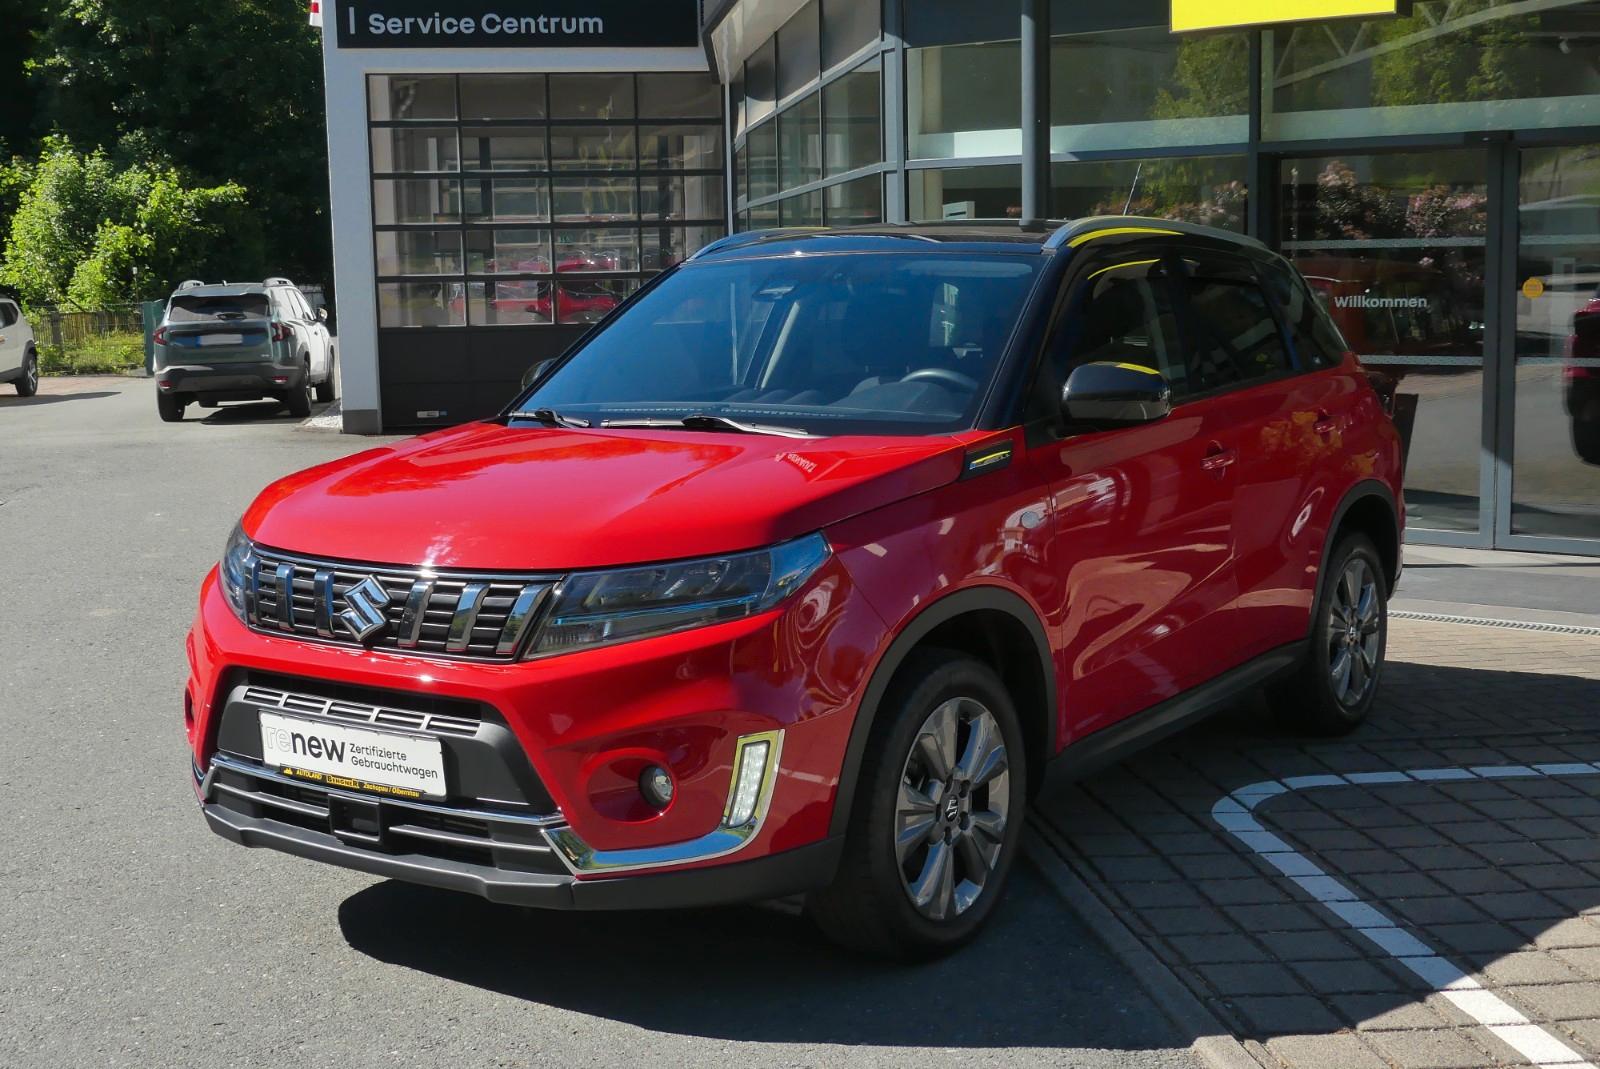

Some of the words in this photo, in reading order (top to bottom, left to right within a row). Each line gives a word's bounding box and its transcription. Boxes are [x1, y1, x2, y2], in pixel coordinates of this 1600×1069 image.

[368, 12, 476, 34] Service
[481, 13, 604, 34] Centrum
[1334, 296, 1428, 308] Willkommen
[265, 725, 346, 763] renew
[349, 743, 407, 761] Zertifizierte
[296, 769, 322, 780] AUTOLAND
[351, 755, 438, 779] Gebrauchtwagen
